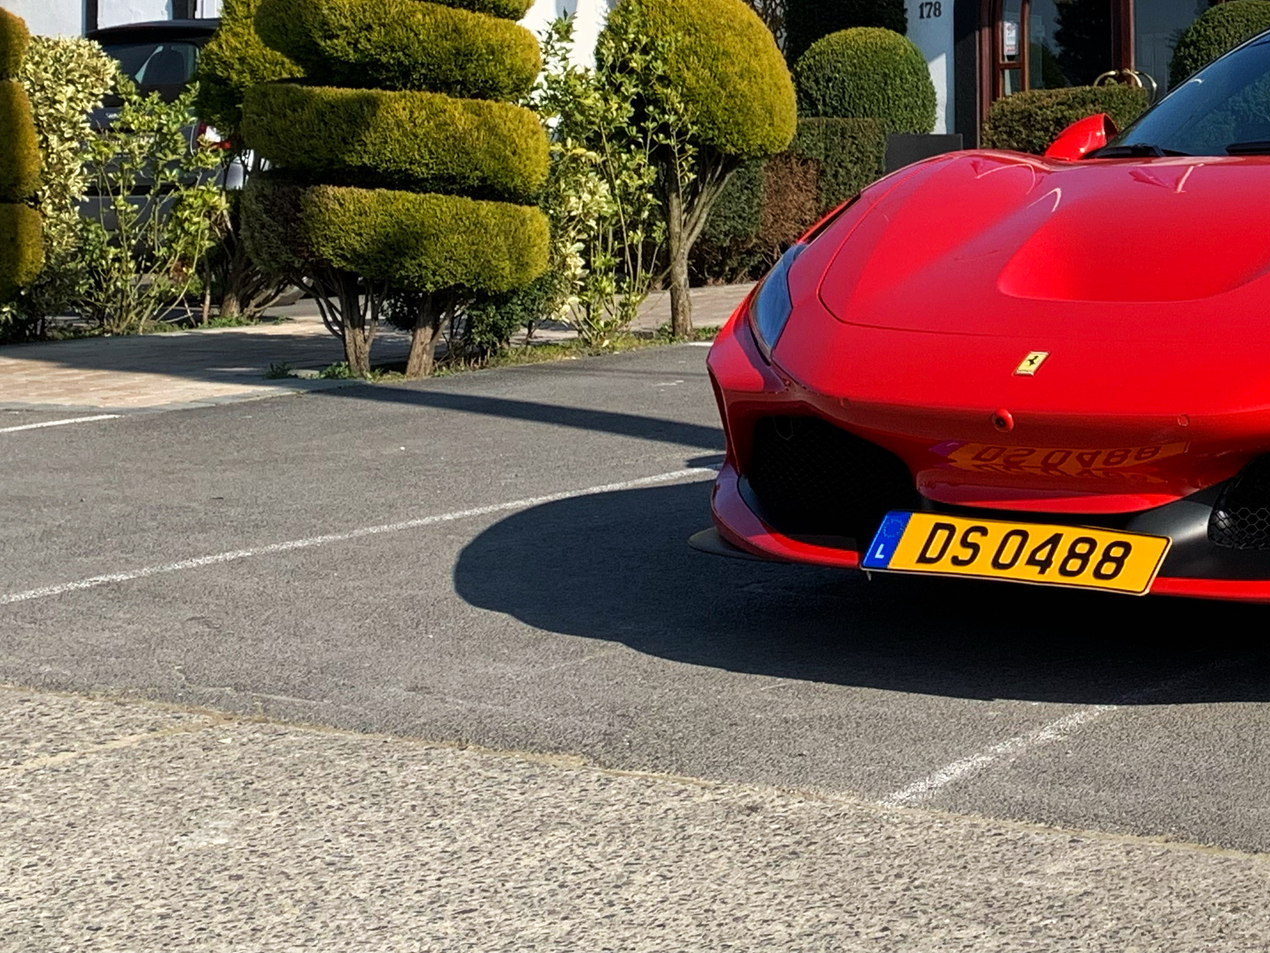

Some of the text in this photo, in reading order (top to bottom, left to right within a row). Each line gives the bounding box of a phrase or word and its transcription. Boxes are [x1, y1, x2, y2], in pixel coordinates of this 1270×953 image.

[918, 1, 942, 19] 178
[874, 522, 1133, 581] L DS 0488
